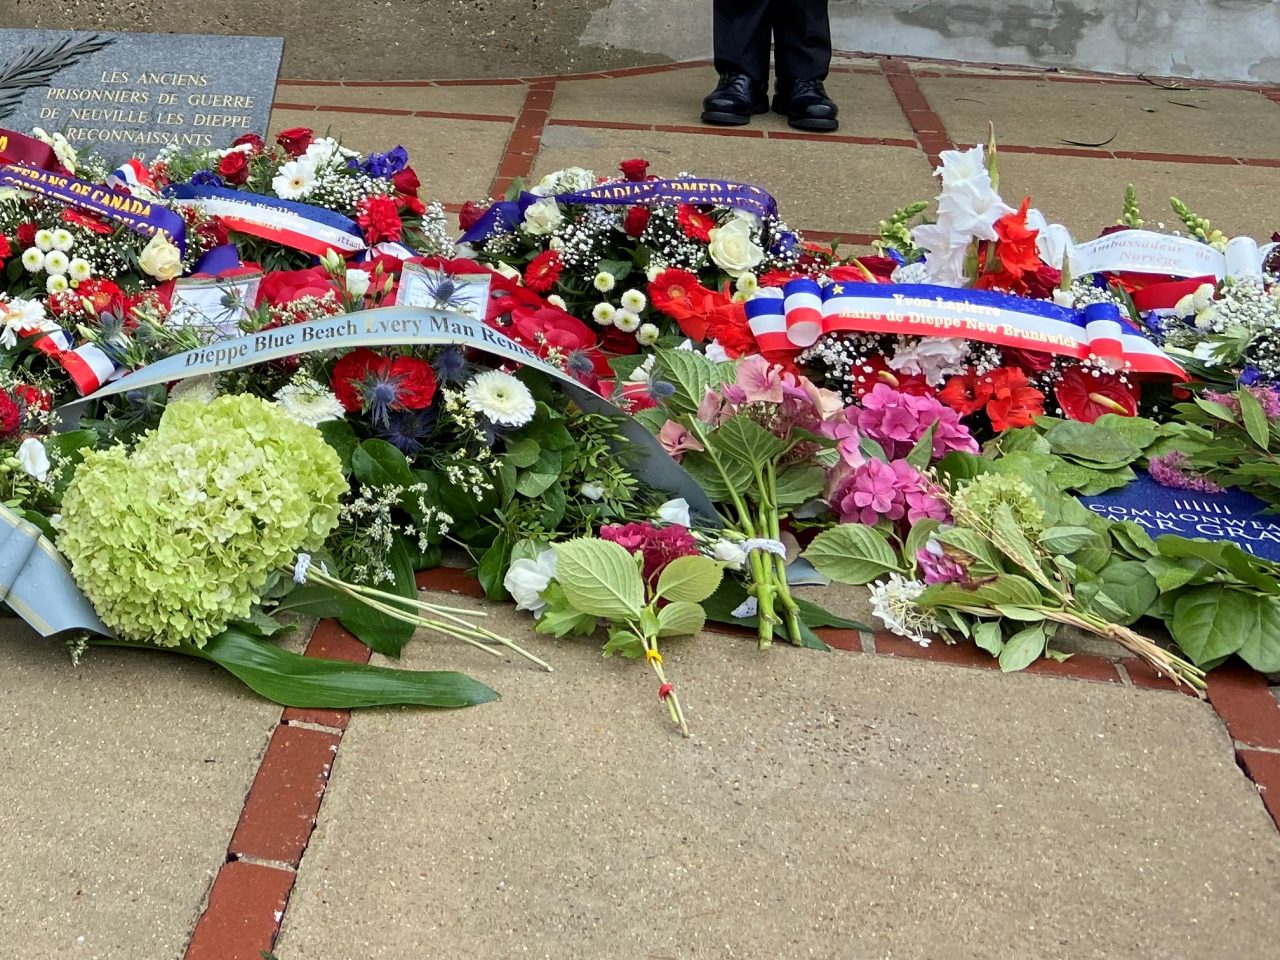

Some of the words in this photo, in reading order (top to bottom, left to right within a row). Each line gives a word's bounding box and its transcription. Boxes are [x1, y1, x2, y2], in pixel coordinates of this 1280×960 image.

[100, 71, 129, 85] LES
[136, 72, 208, 87] ANCIENS
[45, 88, 149, 104] PRISONNIERS
[158, 93, 179, 105] DE
[188, 93, 255, 109] GUERRE
[39, 107, 61, 120] DE
[69, 109, 148, 124] NEUVILLE
[157, 112, 185, 126] LES
[193, 113, 252, 128] DIEPPE
[66, 126, 213, 147] RECONNAISSANTS
[69, 182, 91, 196] OF
[91, 190, 152, 218] CANADA
[1195, 251, 1212, 261] de
[892, 293, 932, 308] Yvon
[936, 296, 1002, 317] Lapierre
[838, 307, 882, 321] Maire
[886, 309, 904, 322] de
[909, 311, 962, 329] Dieppe
[964, 317, 998, 335] New
[1001, 325, 1079, 348] Brunswick
[184, 342, 249, 367] Dieppe
[254, 330, 295, 353] Blue
[301, 320, 358, 343] Beach
[363, 315, 422, 337] Every
[429, 315, 475, 338] Man
